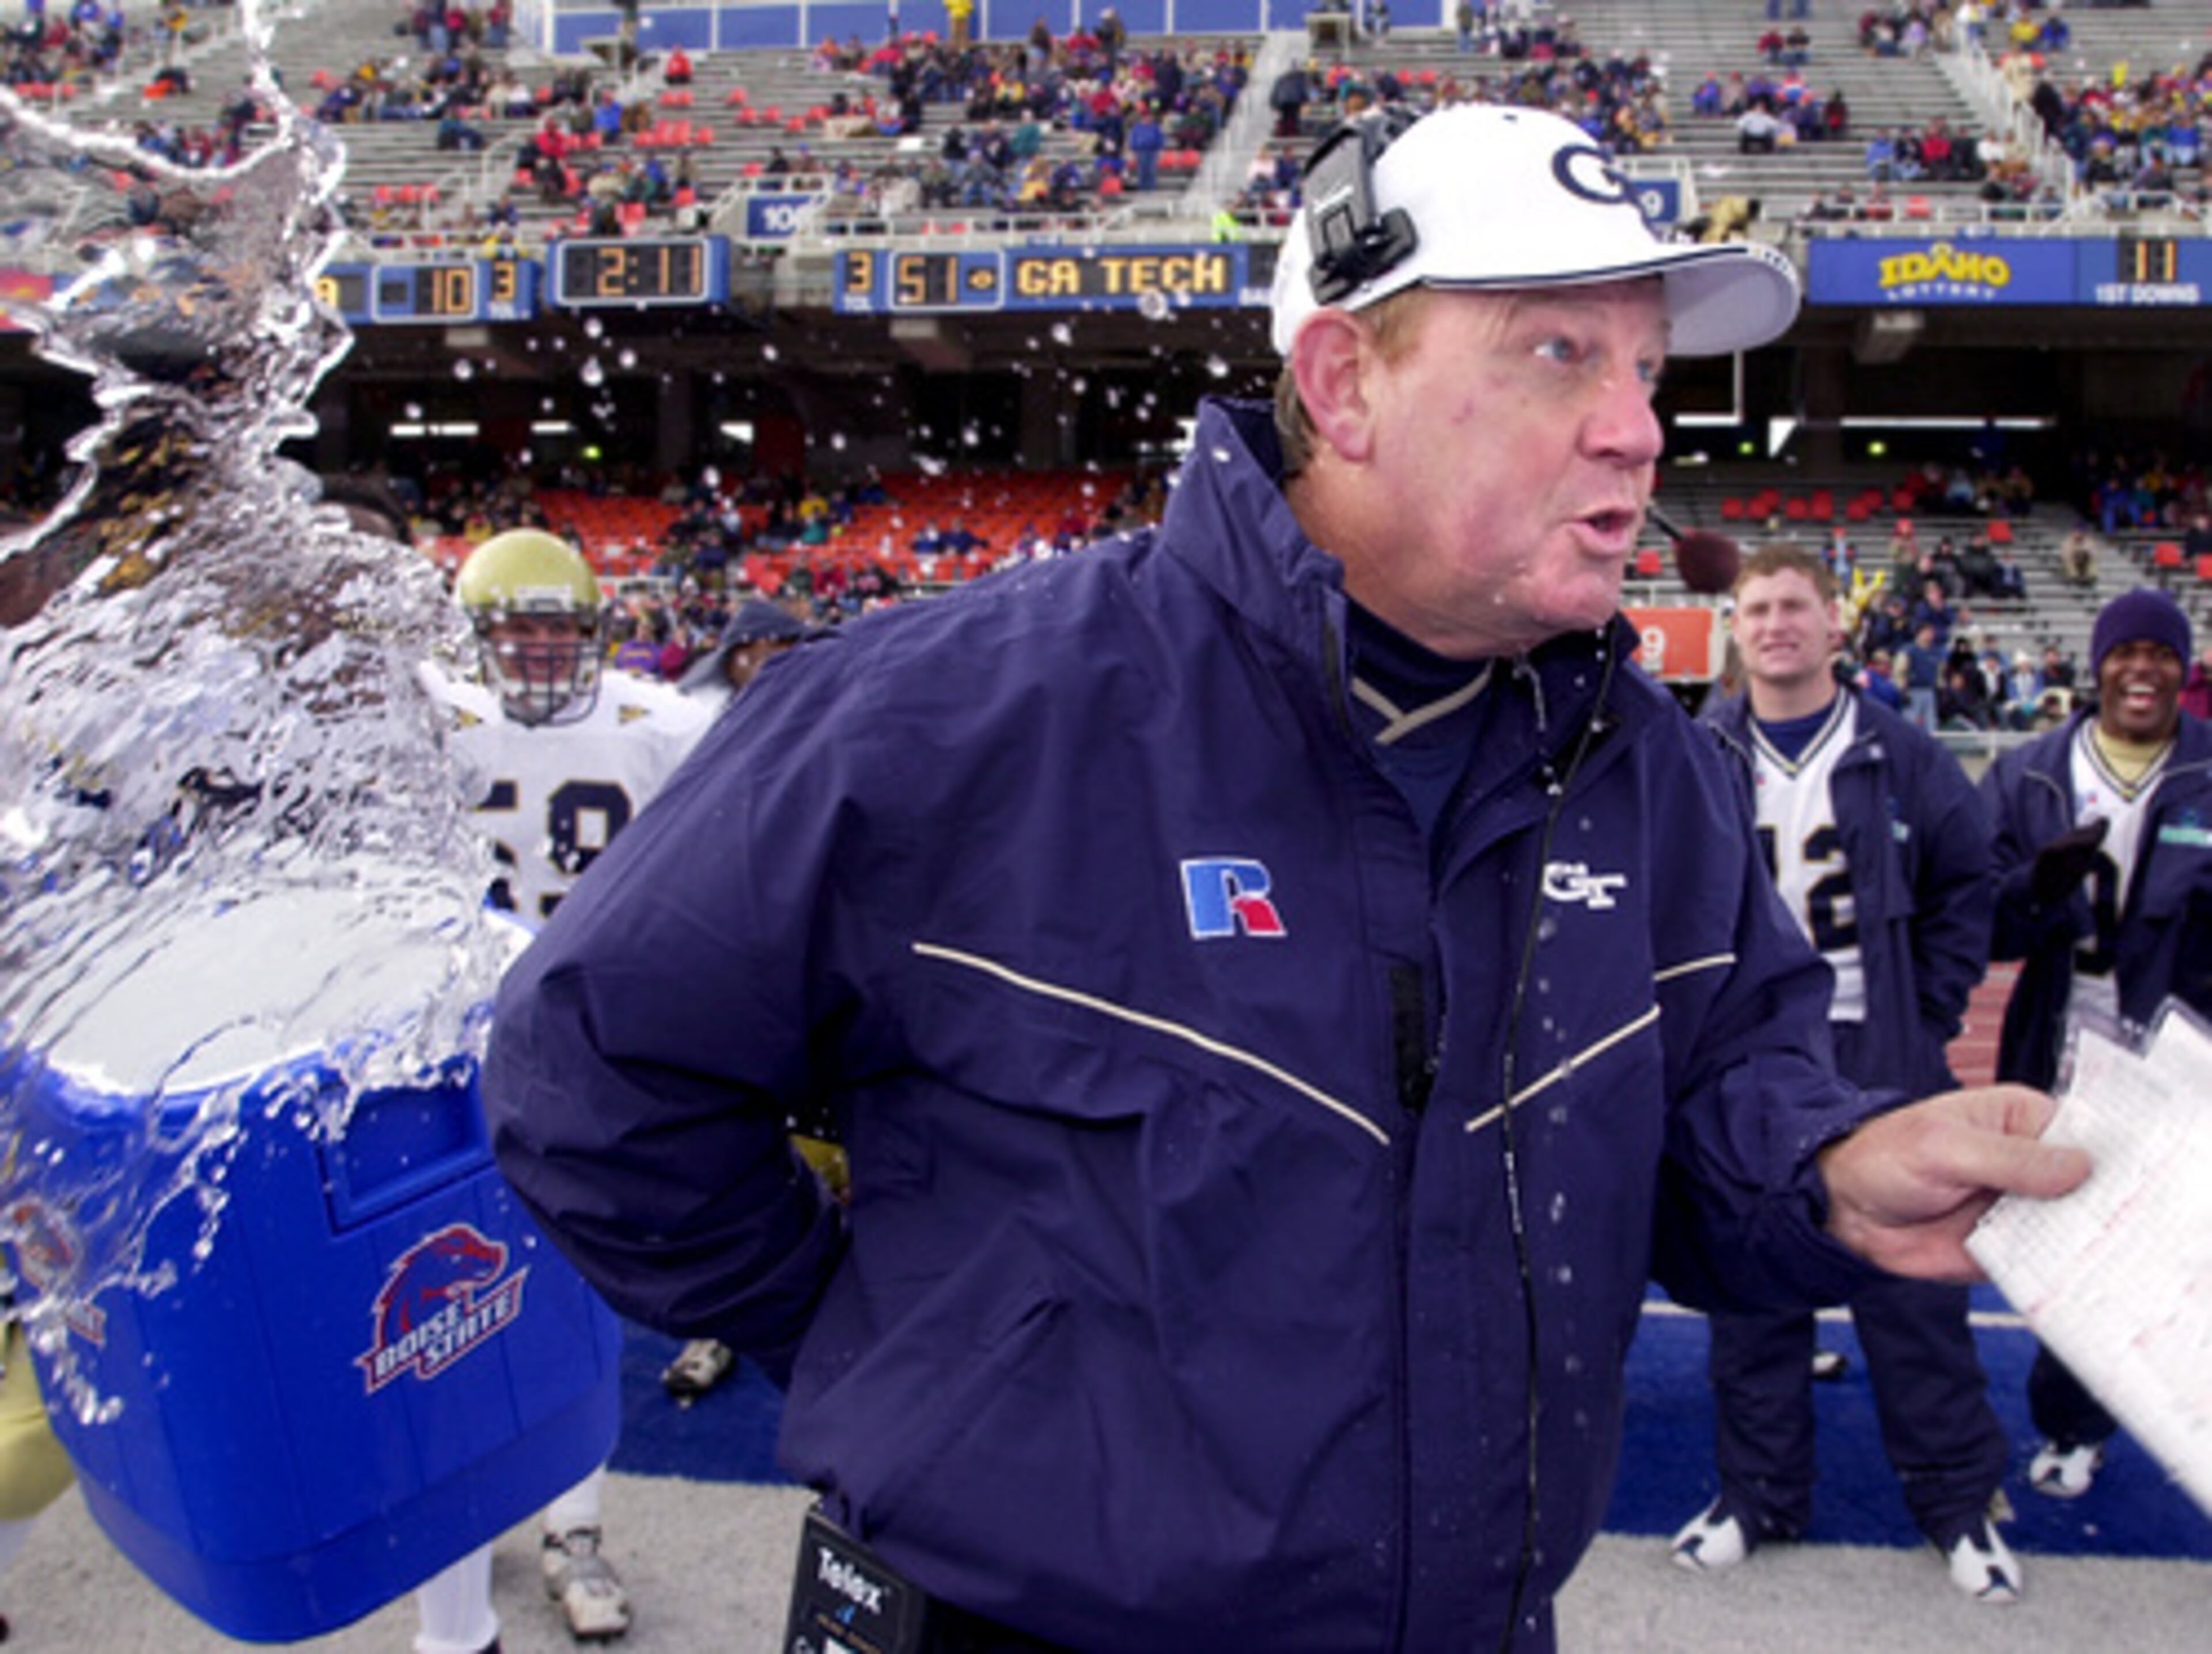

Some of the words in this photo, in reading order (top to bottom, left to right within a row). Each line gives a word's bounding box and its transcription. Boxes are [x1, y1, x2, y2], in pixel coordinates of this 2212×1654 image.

[494, 261, 516, 301] 3
[598, 247, 702, 295] 2:11
[847, 251, 873, 293] 3
[898, 255, 957, 305] 51
[1016, 258, 1081, 295] GA
[1100, 256, 1226, 294] TECH
[1878, 242, 2011, 288] IDAHO
[2135, 240, 2177, 283] 11
[433, 268, 471, 315] 10
[1887, 283, 1996, 302] LOTTERY
[1641, 625, 1666, 672] 9
[1180, 857, 1287, 940] R
[1542, 862, 1627, 909] GT
[376, 1299, 463, 1376] BOISE
[425, 1289, 511, 1372] STATE
[817, 1547, 882, 1615] Telex
